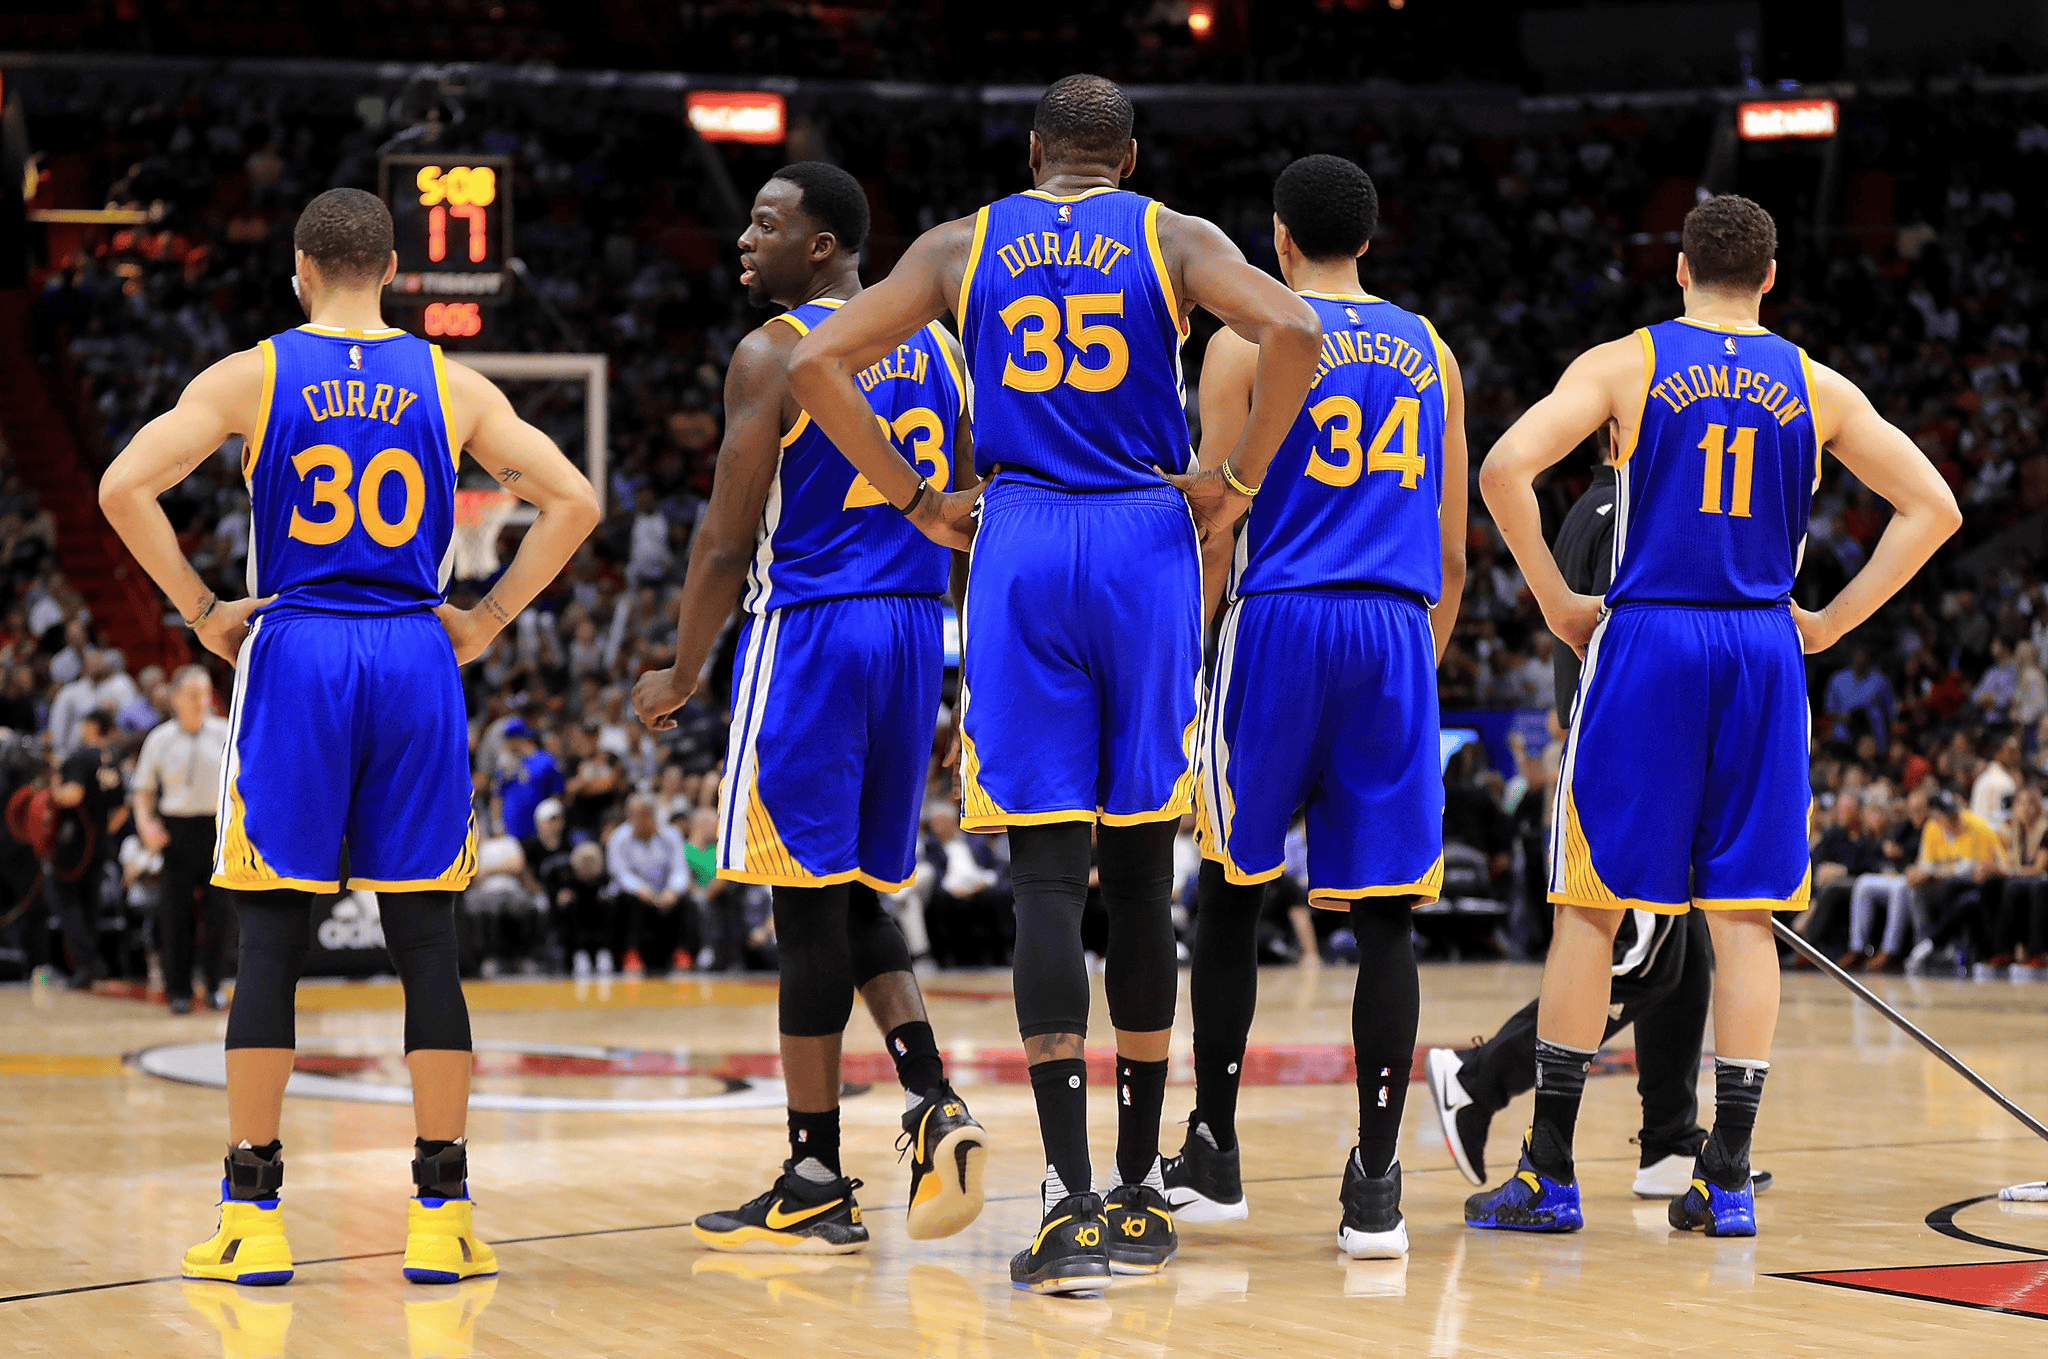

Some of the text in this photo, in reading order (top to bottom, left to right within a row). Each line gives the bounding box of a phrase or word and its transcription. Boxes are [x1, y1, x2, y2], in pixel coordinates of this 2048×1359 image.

[428, 205, 487, 263] 17
[997, 231, 1132, 278] DURANT
[998, 289, 1130, 393] 35
[302, 379, 419, 425] CURRY
[1650, 363, 1807, 427] THOMPSON
[1304, 395, 1427, 490] 34
[1697, 422, 1759, 518] 11
[288, 443, 426, 548] 30
